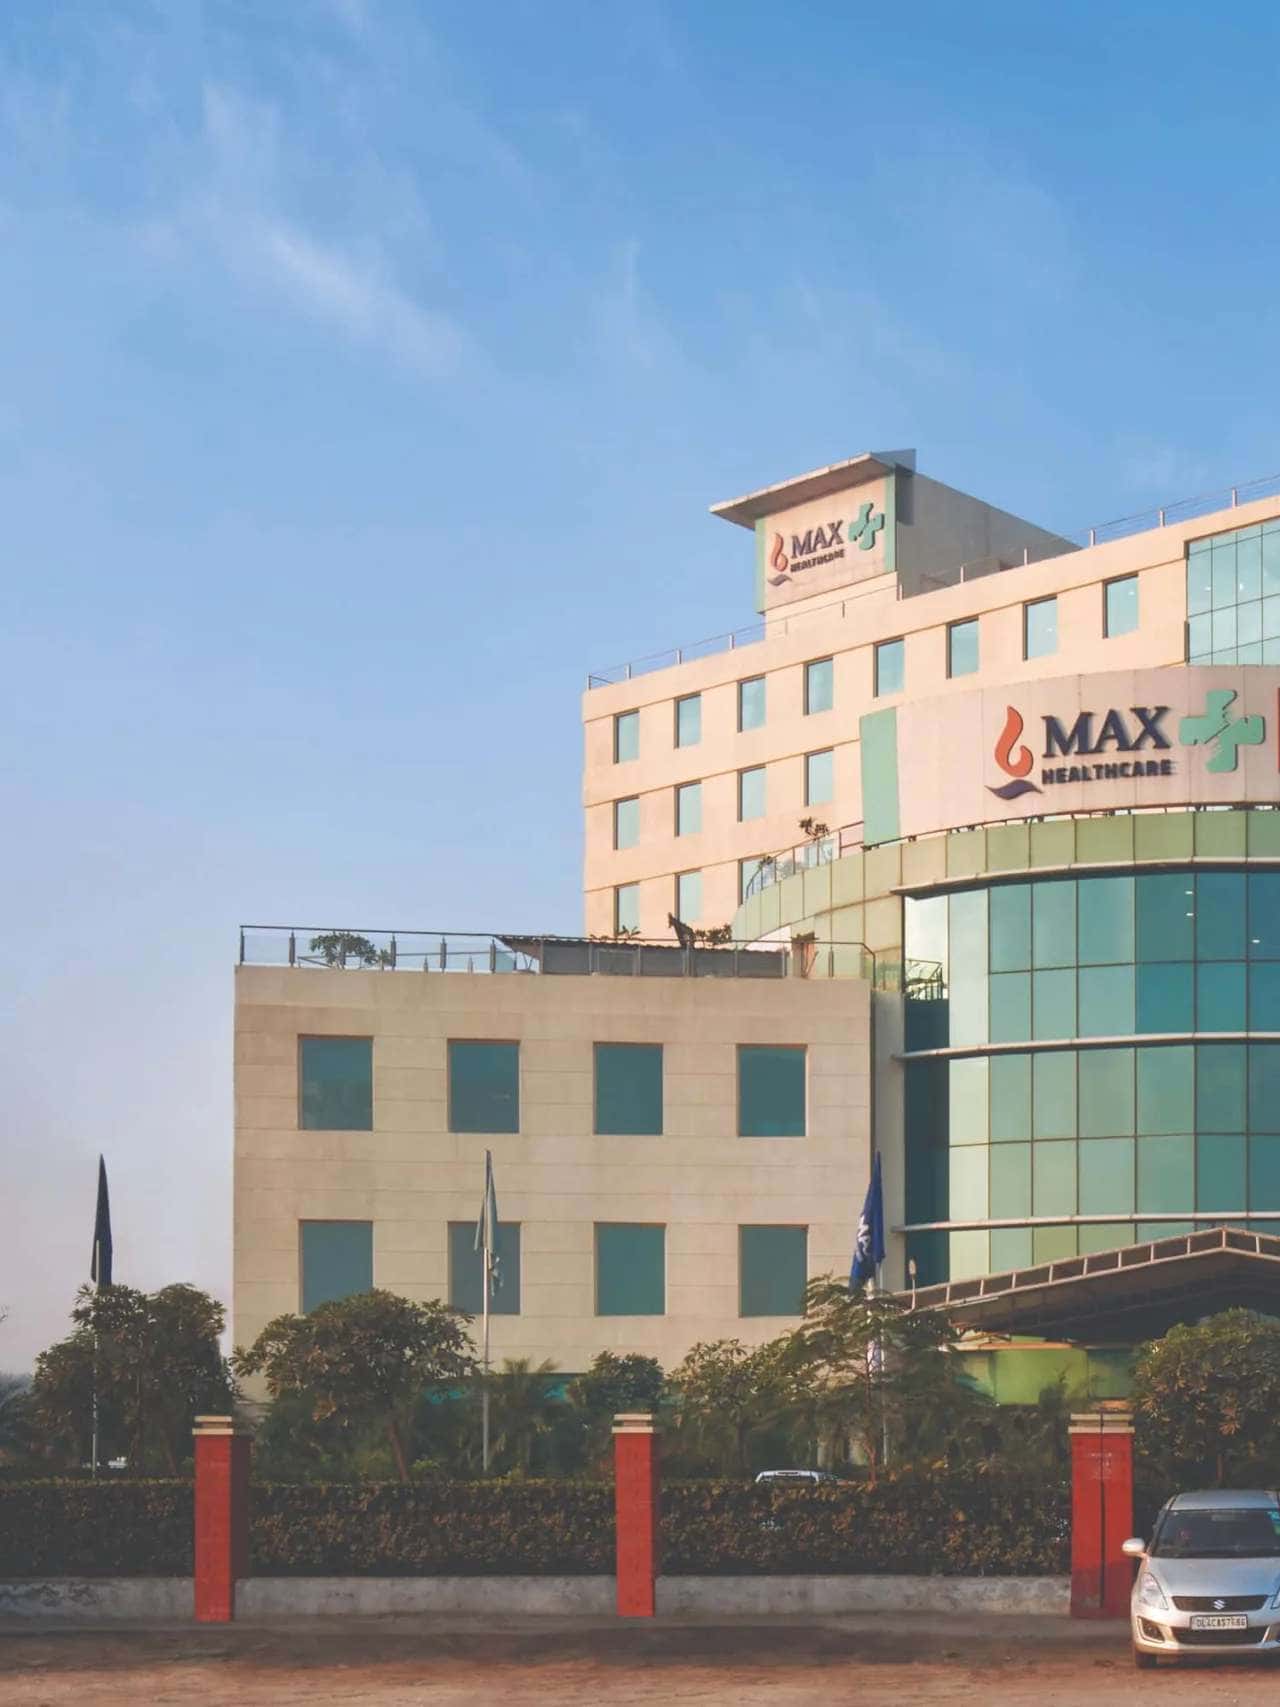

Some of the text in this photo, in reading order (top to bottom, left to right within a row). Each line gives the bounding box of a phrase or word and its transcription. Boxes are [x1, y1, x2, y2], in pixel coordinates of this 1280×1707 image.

[791, 520, 844, 559] MAX
[790, 548, 845, 573] HEALTHCARE
[1041, 706, 1171, 758] MAX
[1041, 758, 1174, 786] HEALTHCARE
